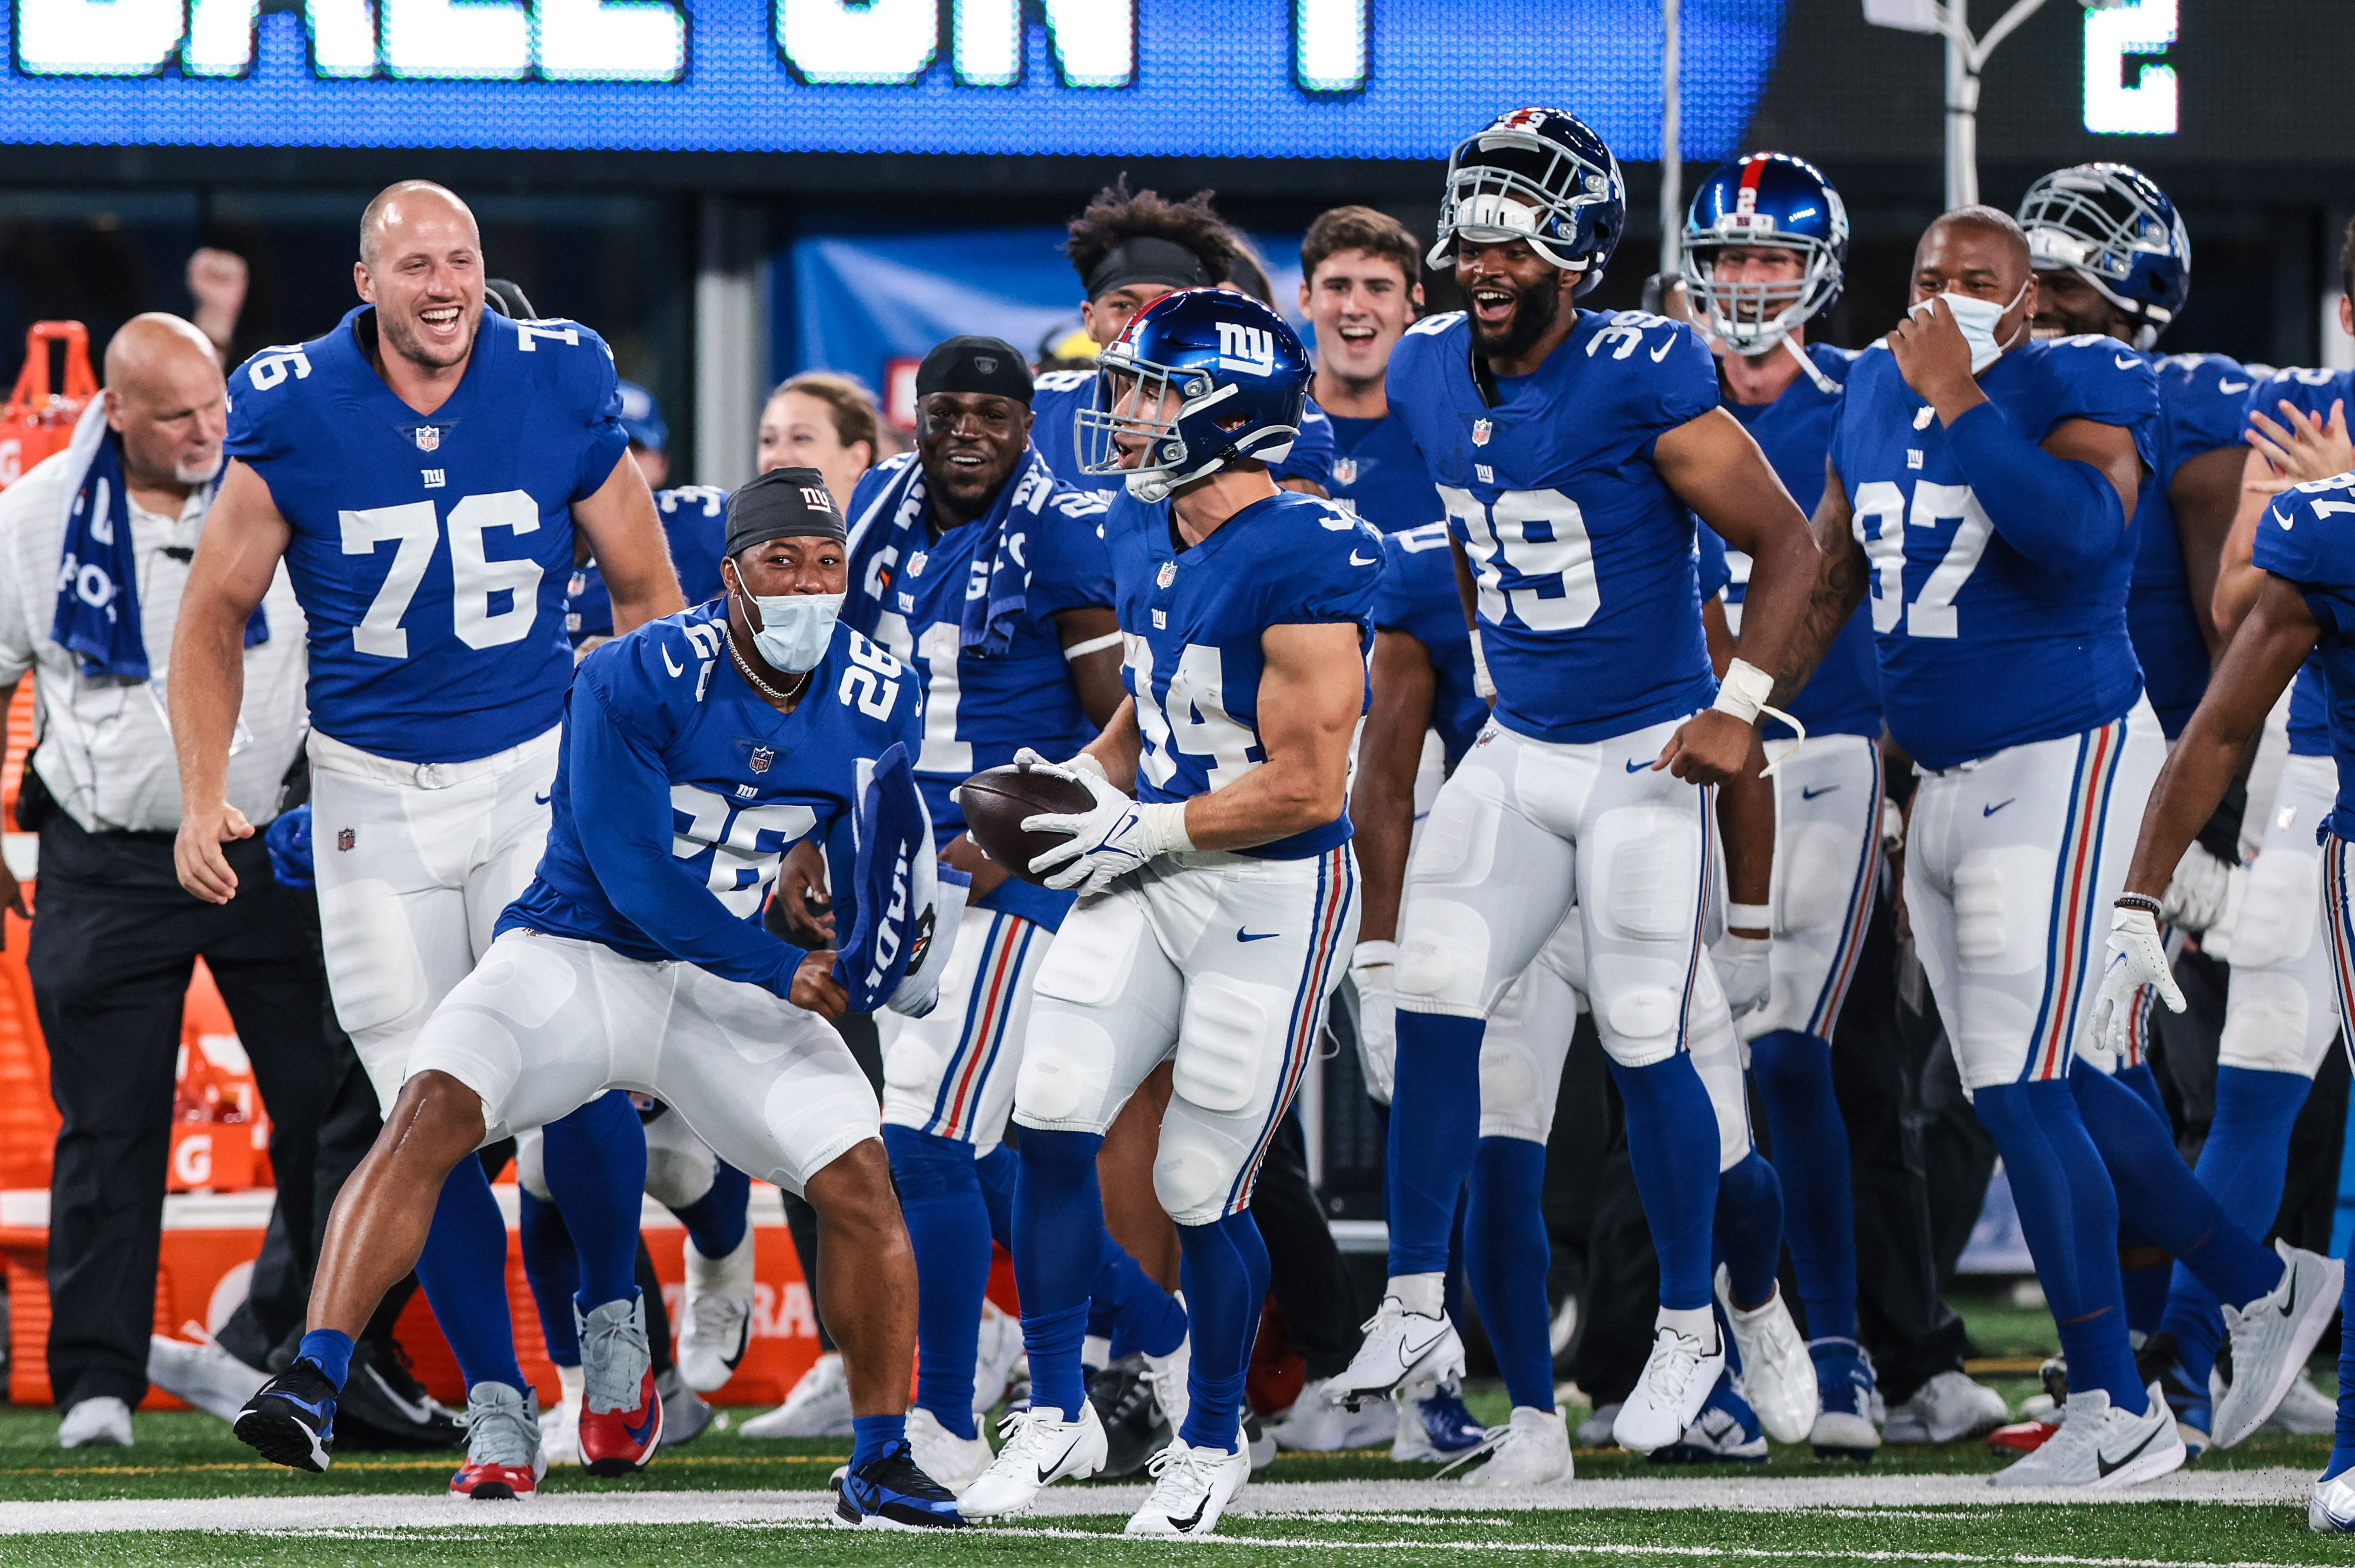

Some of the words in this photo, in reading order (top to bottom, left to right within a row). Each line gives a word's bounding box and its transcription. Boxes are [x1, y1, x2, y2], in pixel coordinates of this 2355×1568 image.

[338, 489, 545, 659] 76
[1435, 482, 1601, 632] 39
[838, 630, 902, 722] 26
[175, 1134, 212, 1185] G
